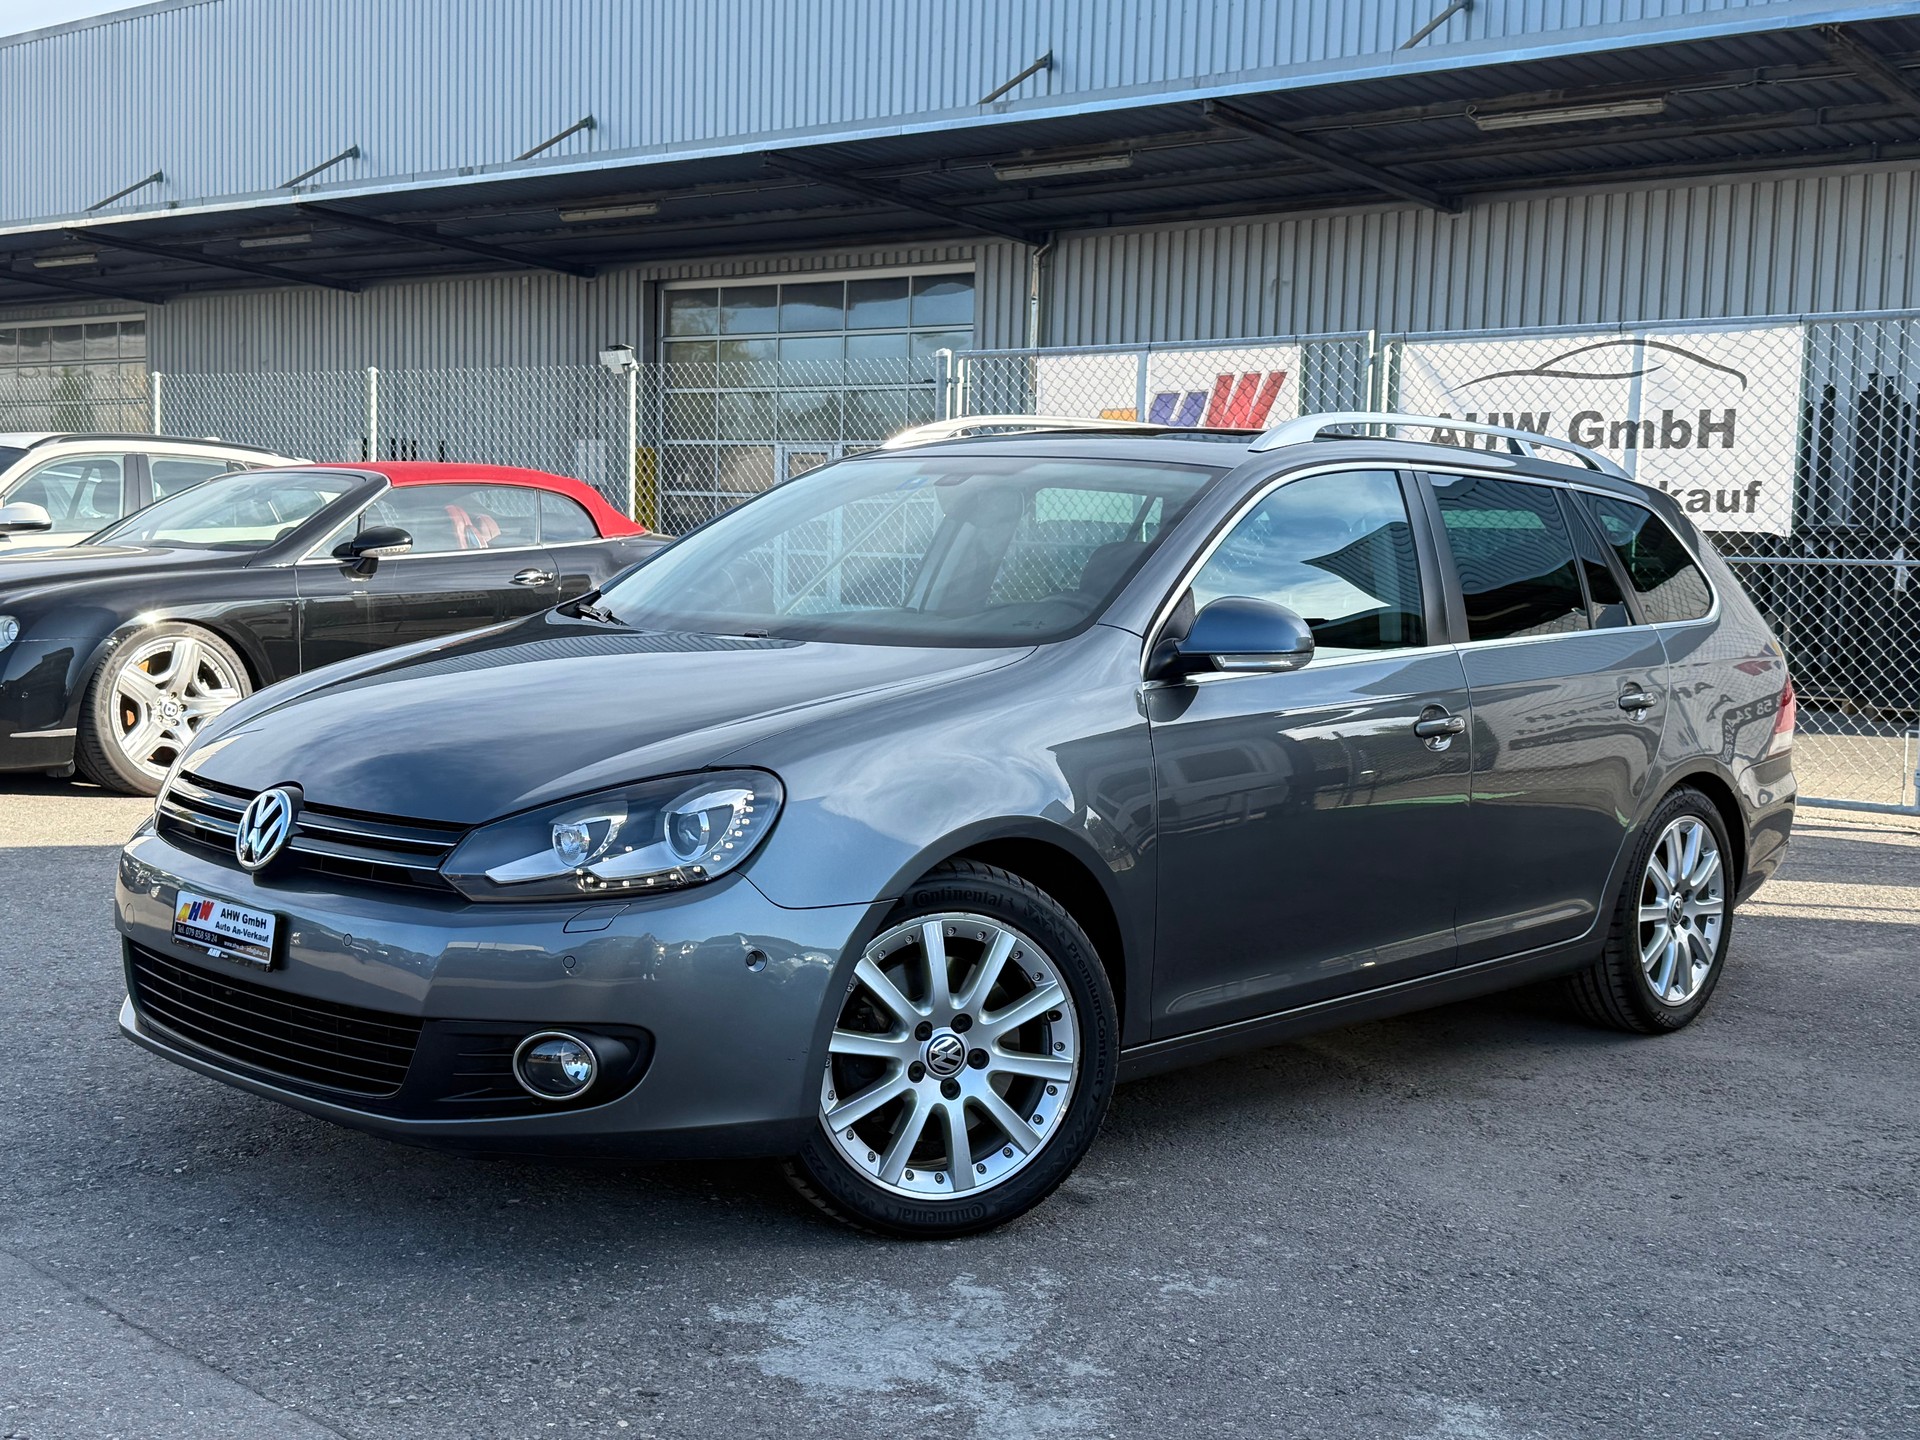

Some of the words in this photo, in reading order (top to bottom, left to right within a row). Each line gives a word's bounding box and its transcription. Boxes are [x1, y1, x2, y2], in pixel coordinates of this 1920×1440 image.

[1568, 409, 1736, 450] GmbH
[912, 887, 1005, 910] Continental
[176, 900, 215, 922] AHW
[220, 908, 240, 922] AHW
[242, 914, 267, 930] GmbH
[215, 921, 231, 932] Auto
[232, 926, 269, 943] An-Verkauf
[1068, 942, 1107, 1086] PremiumContact
